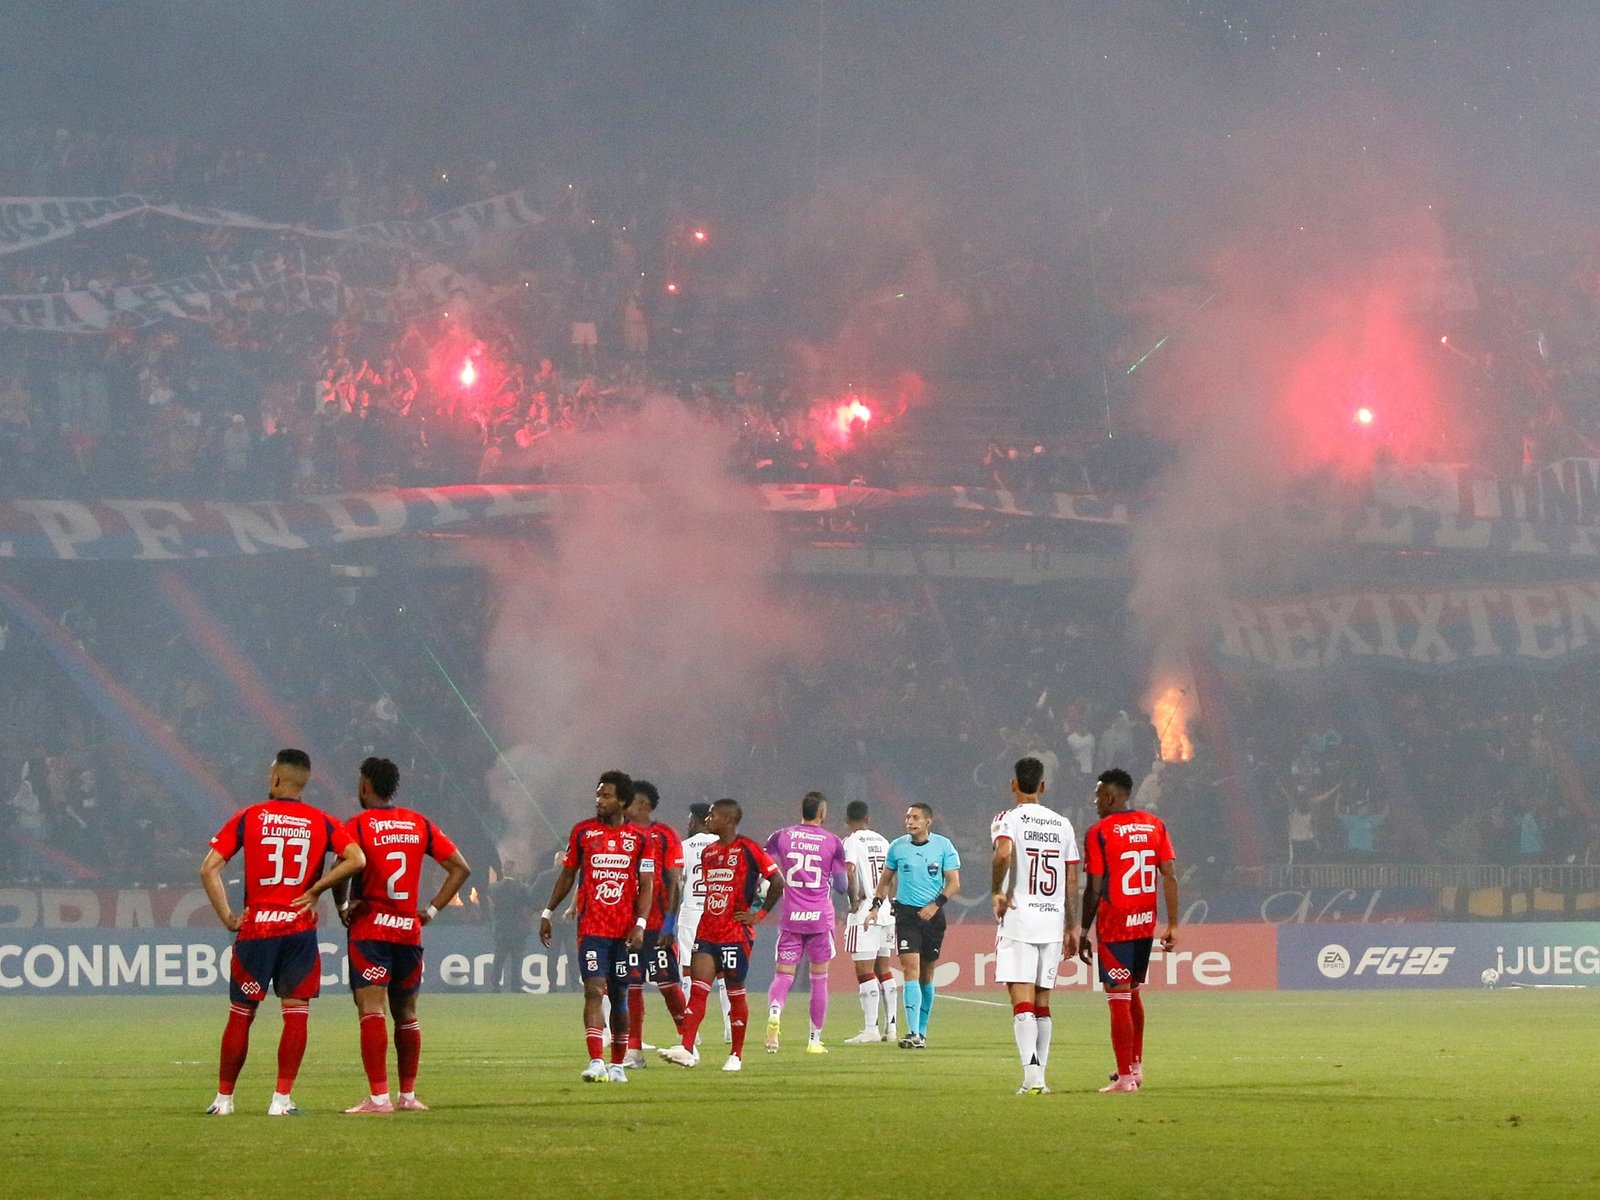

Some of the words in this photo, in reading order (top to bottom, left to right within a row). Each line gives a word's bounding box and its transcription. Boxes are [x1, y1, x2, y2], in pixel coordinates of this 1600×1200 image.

[271, 827, 311, 839] LONDOÑO
[260, 836, 311, 886] 33
[592, 855, 629, 866] Colanta
[386, 851, 408, 899] 2
[786, 851, 822, 888] 25
[1120, 849, 1156, 896] 26
[595, 881, 625, 900] Pool
[374, 913, 414, 930] MAPEI
[790, 911, 822, 920] MAPEI
[1126, 911, 1153, 927] MAPEI
[657, 950, 668, 968] 8
[1324, 952, 1344, 963] EA
